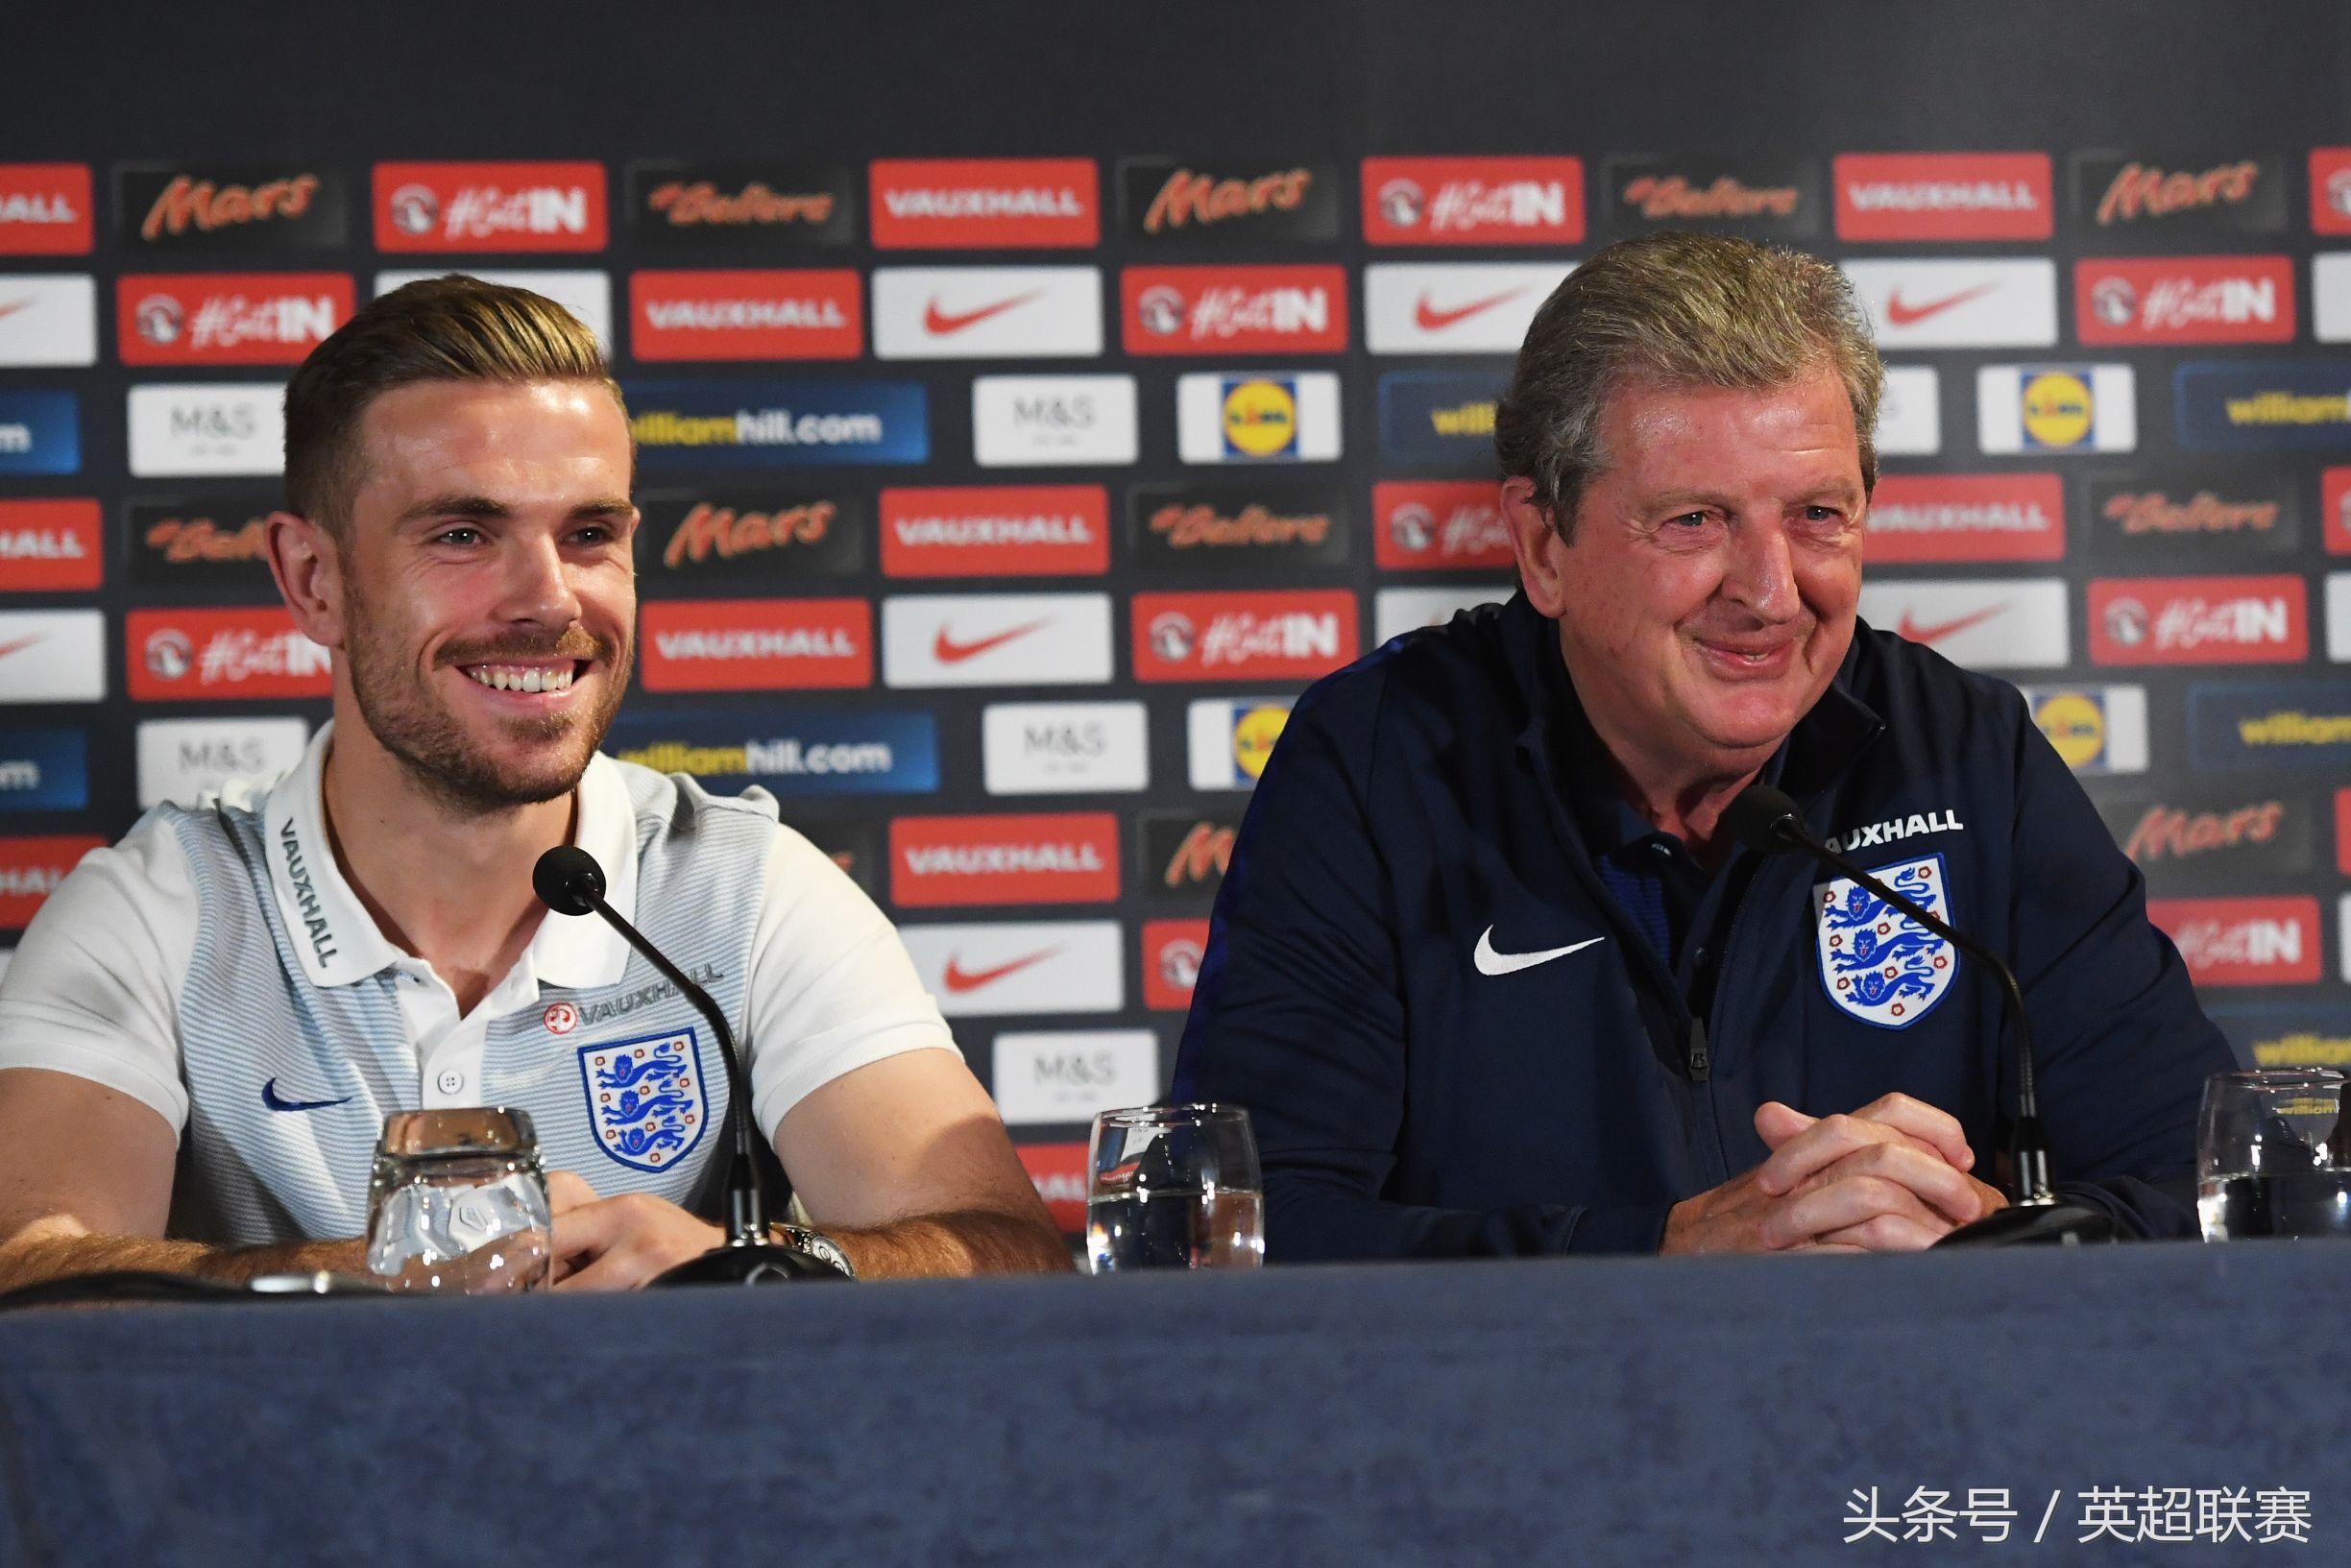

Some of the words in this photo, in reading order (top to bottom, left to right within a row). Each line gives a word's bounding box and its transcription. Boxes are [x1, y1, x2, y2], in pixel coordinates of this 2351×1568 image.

[142, 175, 318, 239] Mars
[884, 187, 1081, 218] VAUXHALL
[1145, 170, 1311, 232] Mars
[1848, 181, 2037, 211] VAUXHALL
[2097, 161, 2257, 225] Mars
[644, 299, 845, 329] VAUXHALL
[632, 409, 883, 446] illiamhill.com
[664, 500, 835, 567] Mars
[894, 514, 1091, 546] VAUXHALL
[654, 628, 855, 660] VAUXHALL
[1823, 808, 1964, 855] AUXHALL
[2123, 800, 2284, 862] Mars
[904, 843, 1103, 875] VAUXHALL
[280, 816, 340, 969] VAUXHALL
[577, 963, 724, 1025] VAUXHLL
